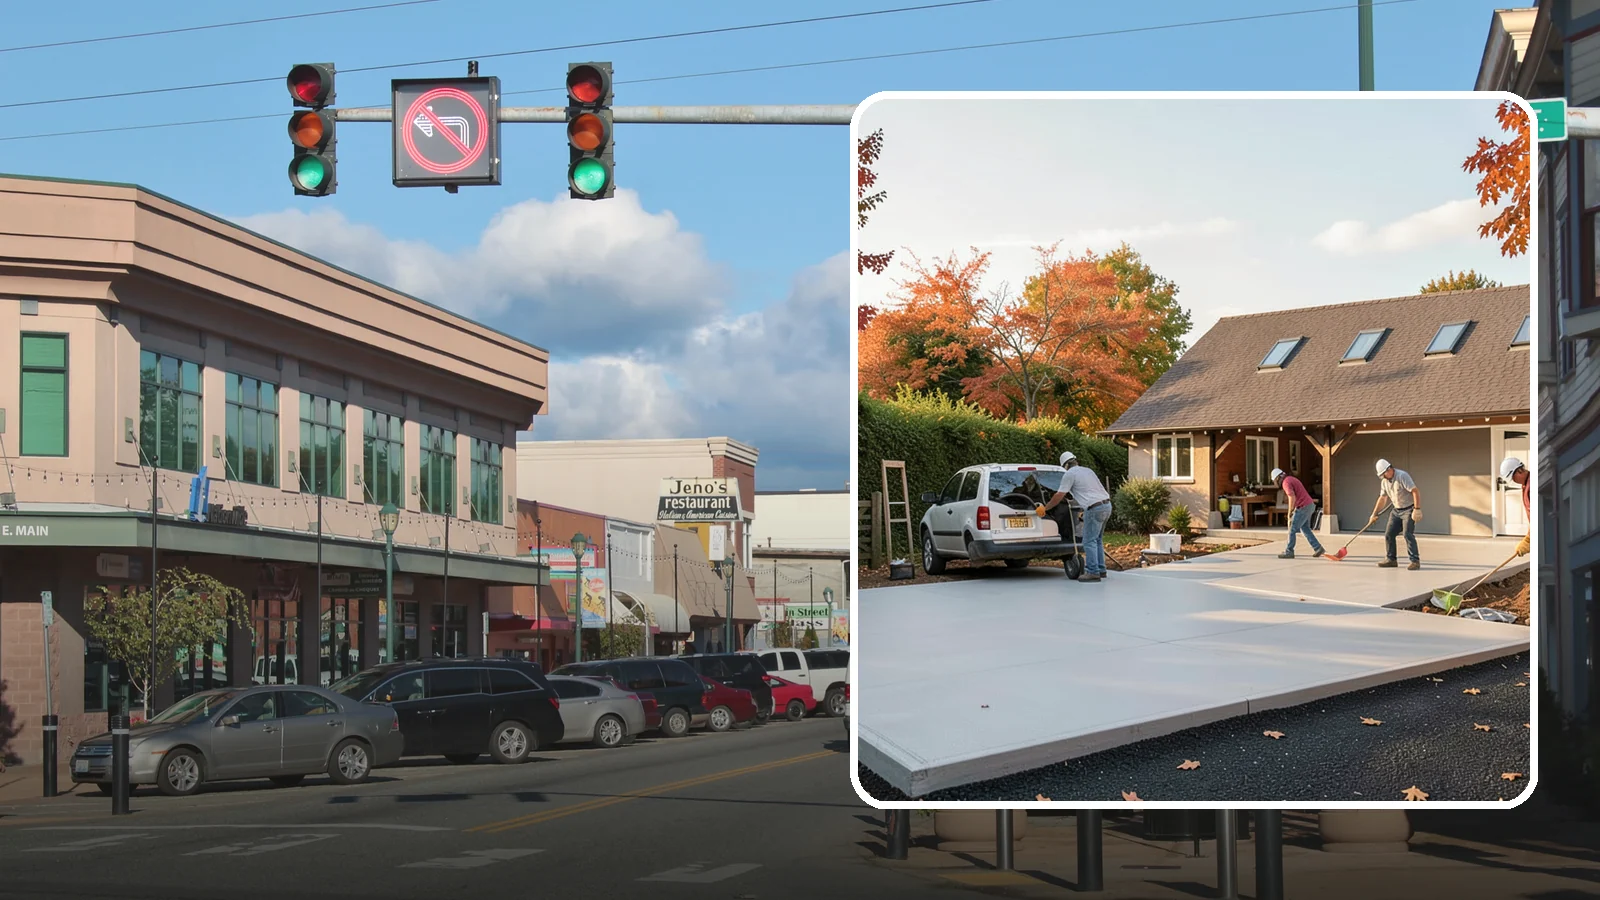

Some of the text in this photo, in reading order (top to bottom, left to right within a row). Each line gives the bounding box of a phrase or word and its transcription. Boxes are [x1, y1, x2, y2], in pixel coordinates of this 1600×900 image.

[670, 480, 727, 494] Jeno's
[665, 496, 730, 509] restaurant
[658, 510, 681, 519] Italian
[686, 510, 714, 519] American
[715, 510, 737, 519] Cuisine
[2, 526, 48, 536] E. MAIN
[798, 608, 829, 616] Street
